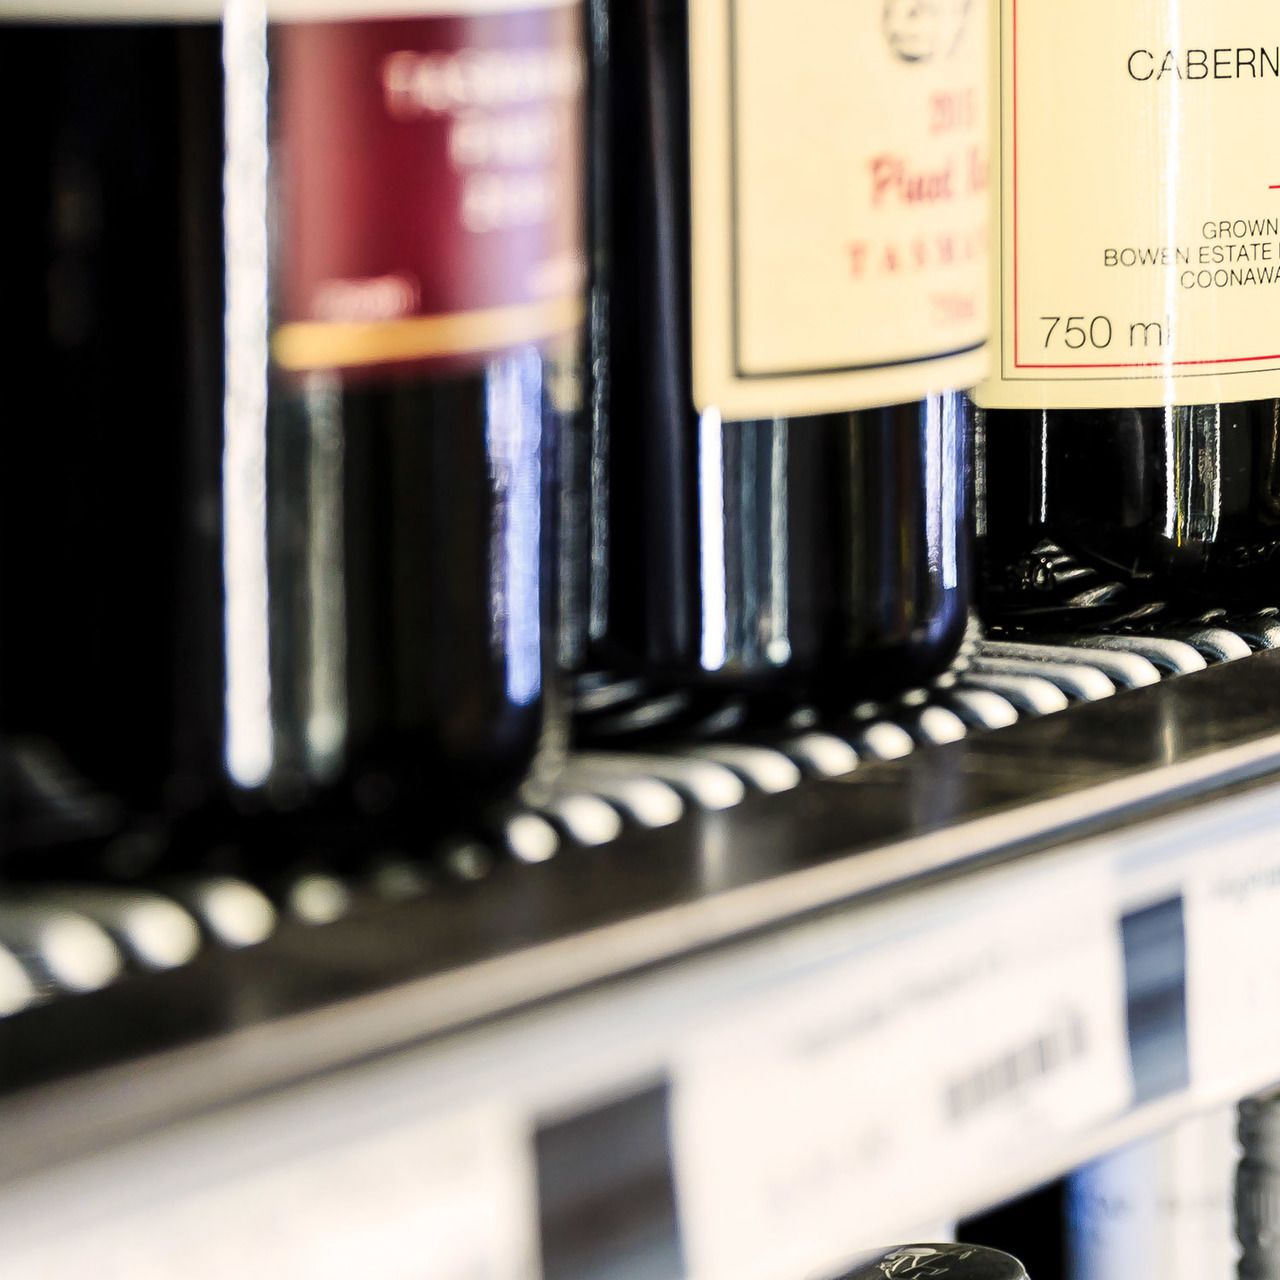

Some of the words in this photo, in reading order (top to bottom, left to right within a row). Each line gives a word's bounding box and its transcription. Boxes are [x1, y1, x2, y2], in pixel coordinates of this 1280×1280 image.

[1202, 218, 1278, 240] GROWN
[1104, 247, 1190, 267] BOWEN
[1199, 242, 1272, 264] ESTATE
[1039, 315, 1113, 349] 750
